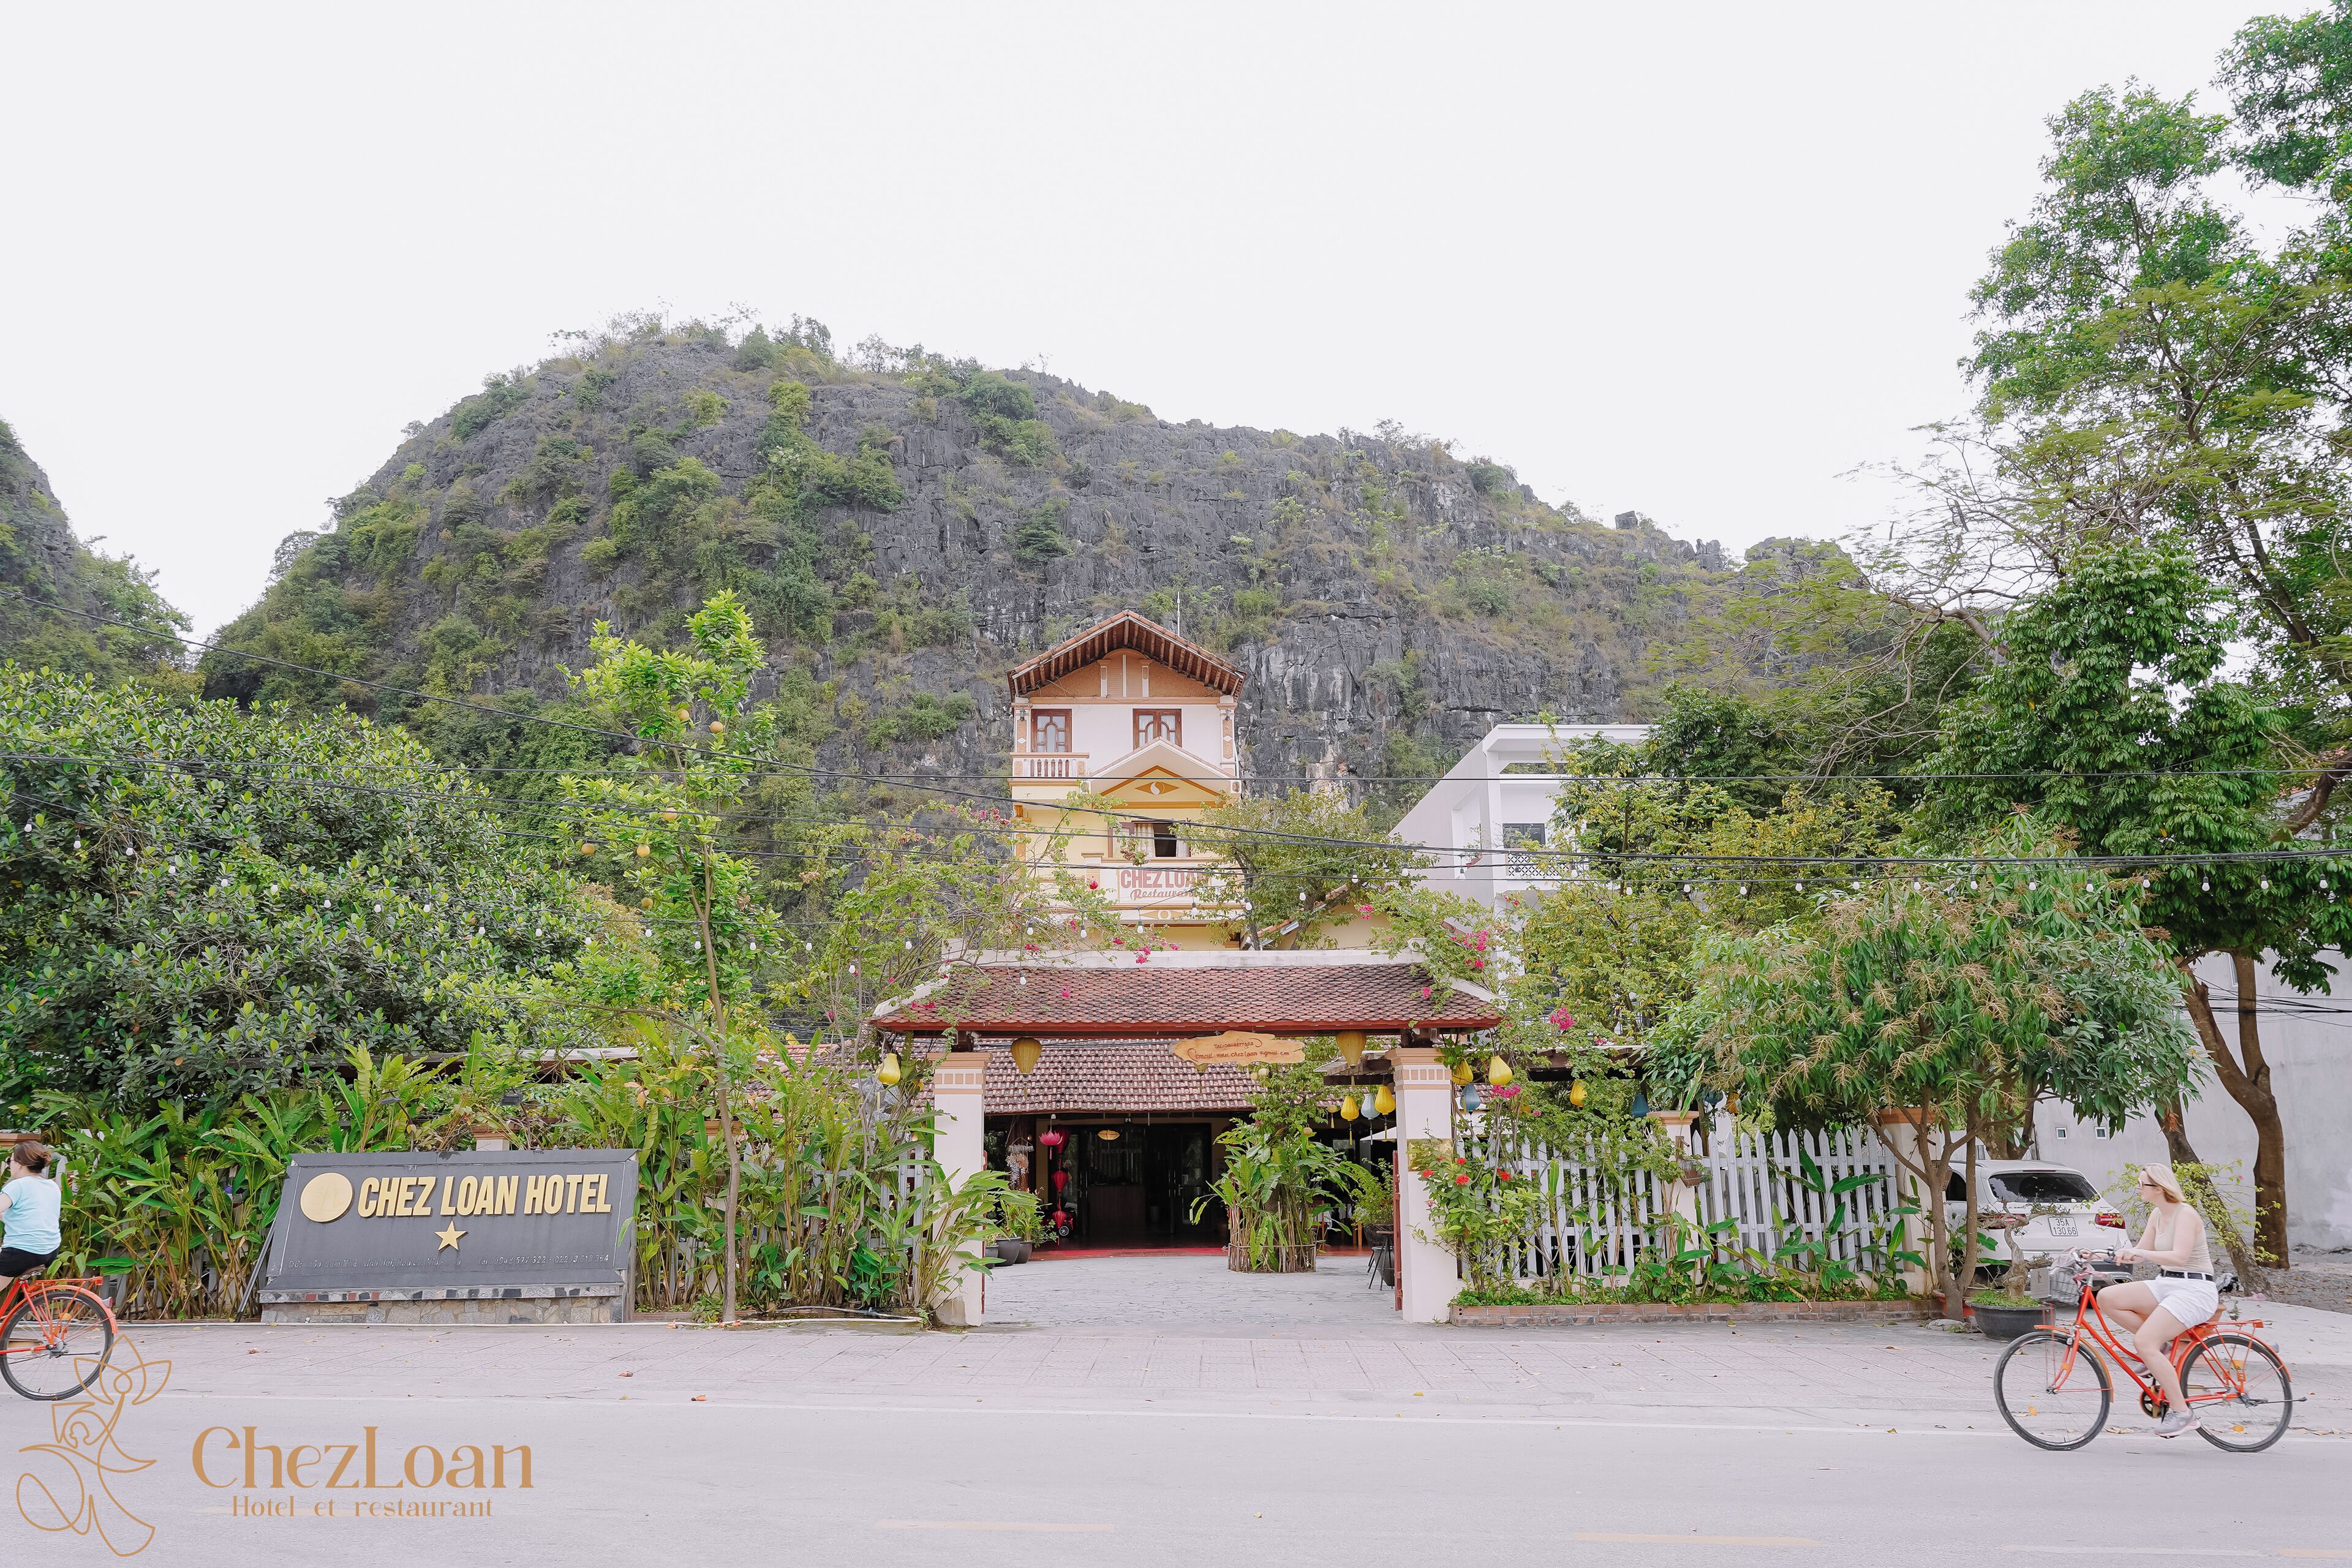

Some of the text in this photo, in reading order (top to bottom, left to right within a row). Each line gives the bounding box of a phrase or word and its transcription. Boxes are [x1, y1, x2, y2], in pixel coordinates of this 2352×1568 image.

[1121, 870, 1162, 888] CHEZ
[1130, 889, 1196, 900] Restauran
[357, 1173, 612, 1217] CHEZ LOAN HOTEL
